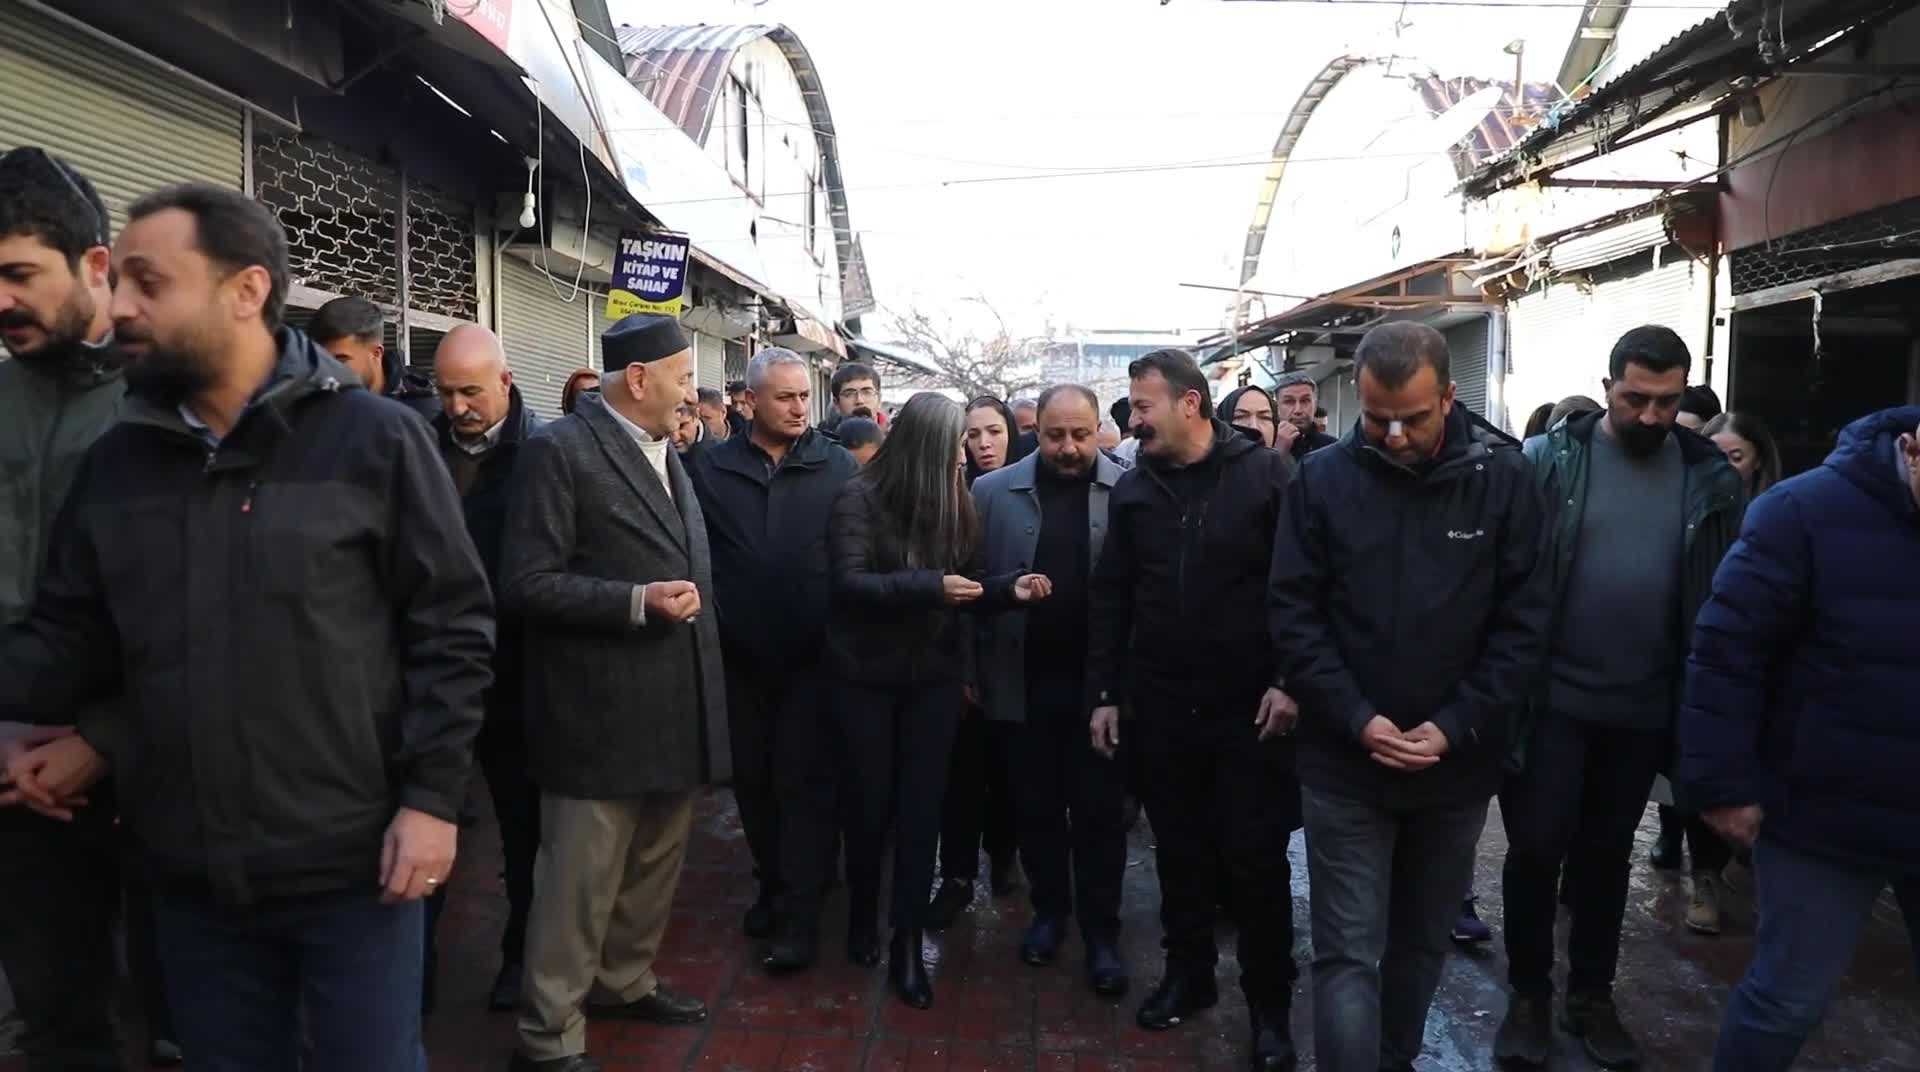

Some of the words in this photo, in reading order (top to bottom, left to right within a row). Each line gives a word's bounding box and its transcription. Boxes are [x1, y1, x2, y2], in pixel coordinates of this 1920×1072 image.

[621, 238, 685, 261] TAŞKIN
[623, 260, 660, 277] KİTAP
[662, 267, 679, 280] VE
[627, 277, 670, 294] SAHAF
